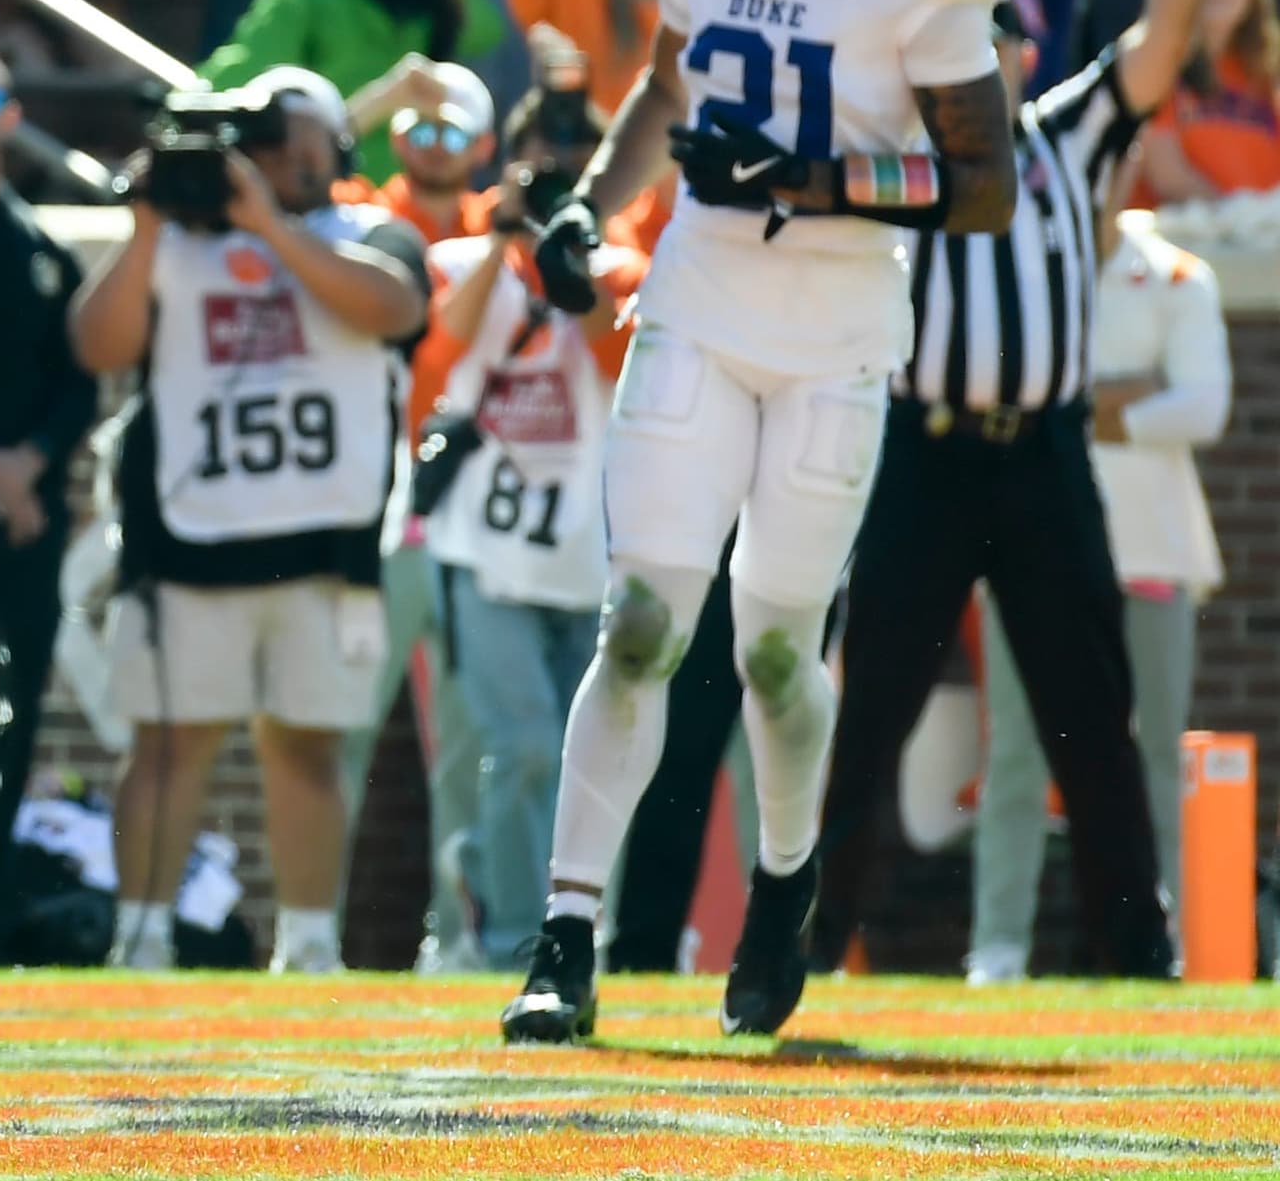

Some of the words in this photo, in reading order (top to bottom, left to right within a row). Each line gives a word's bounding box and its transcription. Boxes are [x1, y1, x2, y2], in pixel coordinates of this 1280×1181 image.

[687, 23, 835, 182] 21
[197, 390, 339, 480] 159
[485, 456, 562, 548] 81
